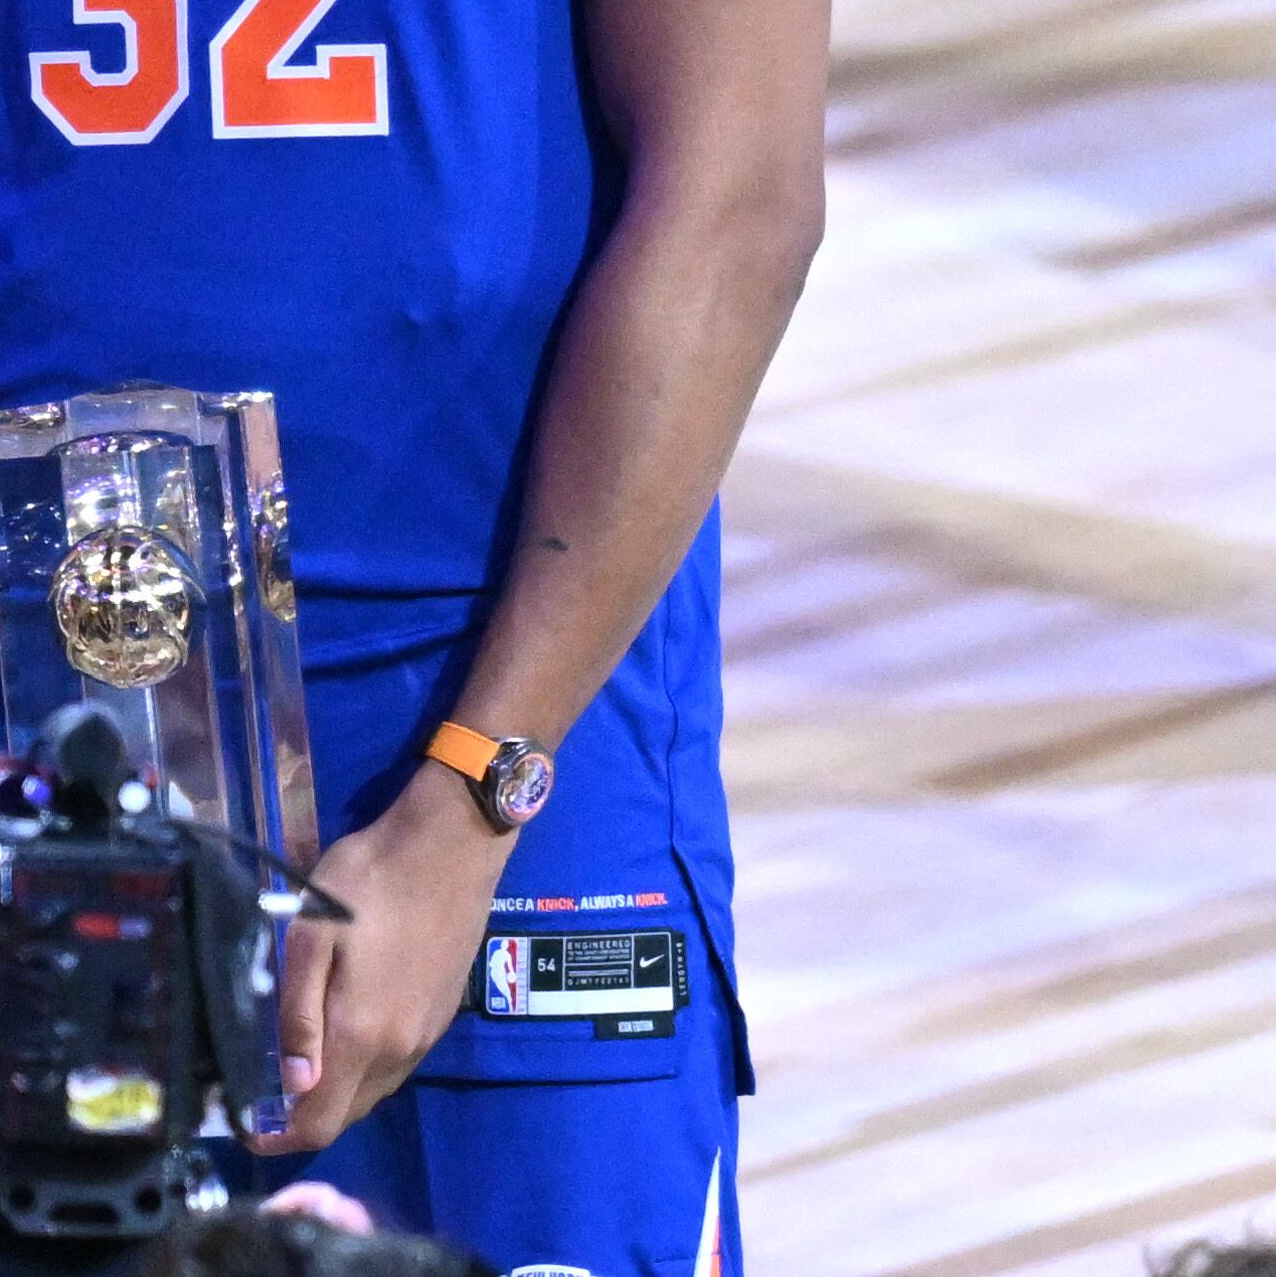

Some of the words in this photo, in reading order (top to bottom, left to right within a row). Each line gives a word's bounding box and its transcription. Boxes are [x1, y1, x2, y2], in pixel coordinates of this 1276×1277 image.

[525, 897, 535, 912] A
[580, 894, 625, 911] ALWAYS
[626, 893, 635, 908] A
[567, 939, 631, 950] ENGINEERED
